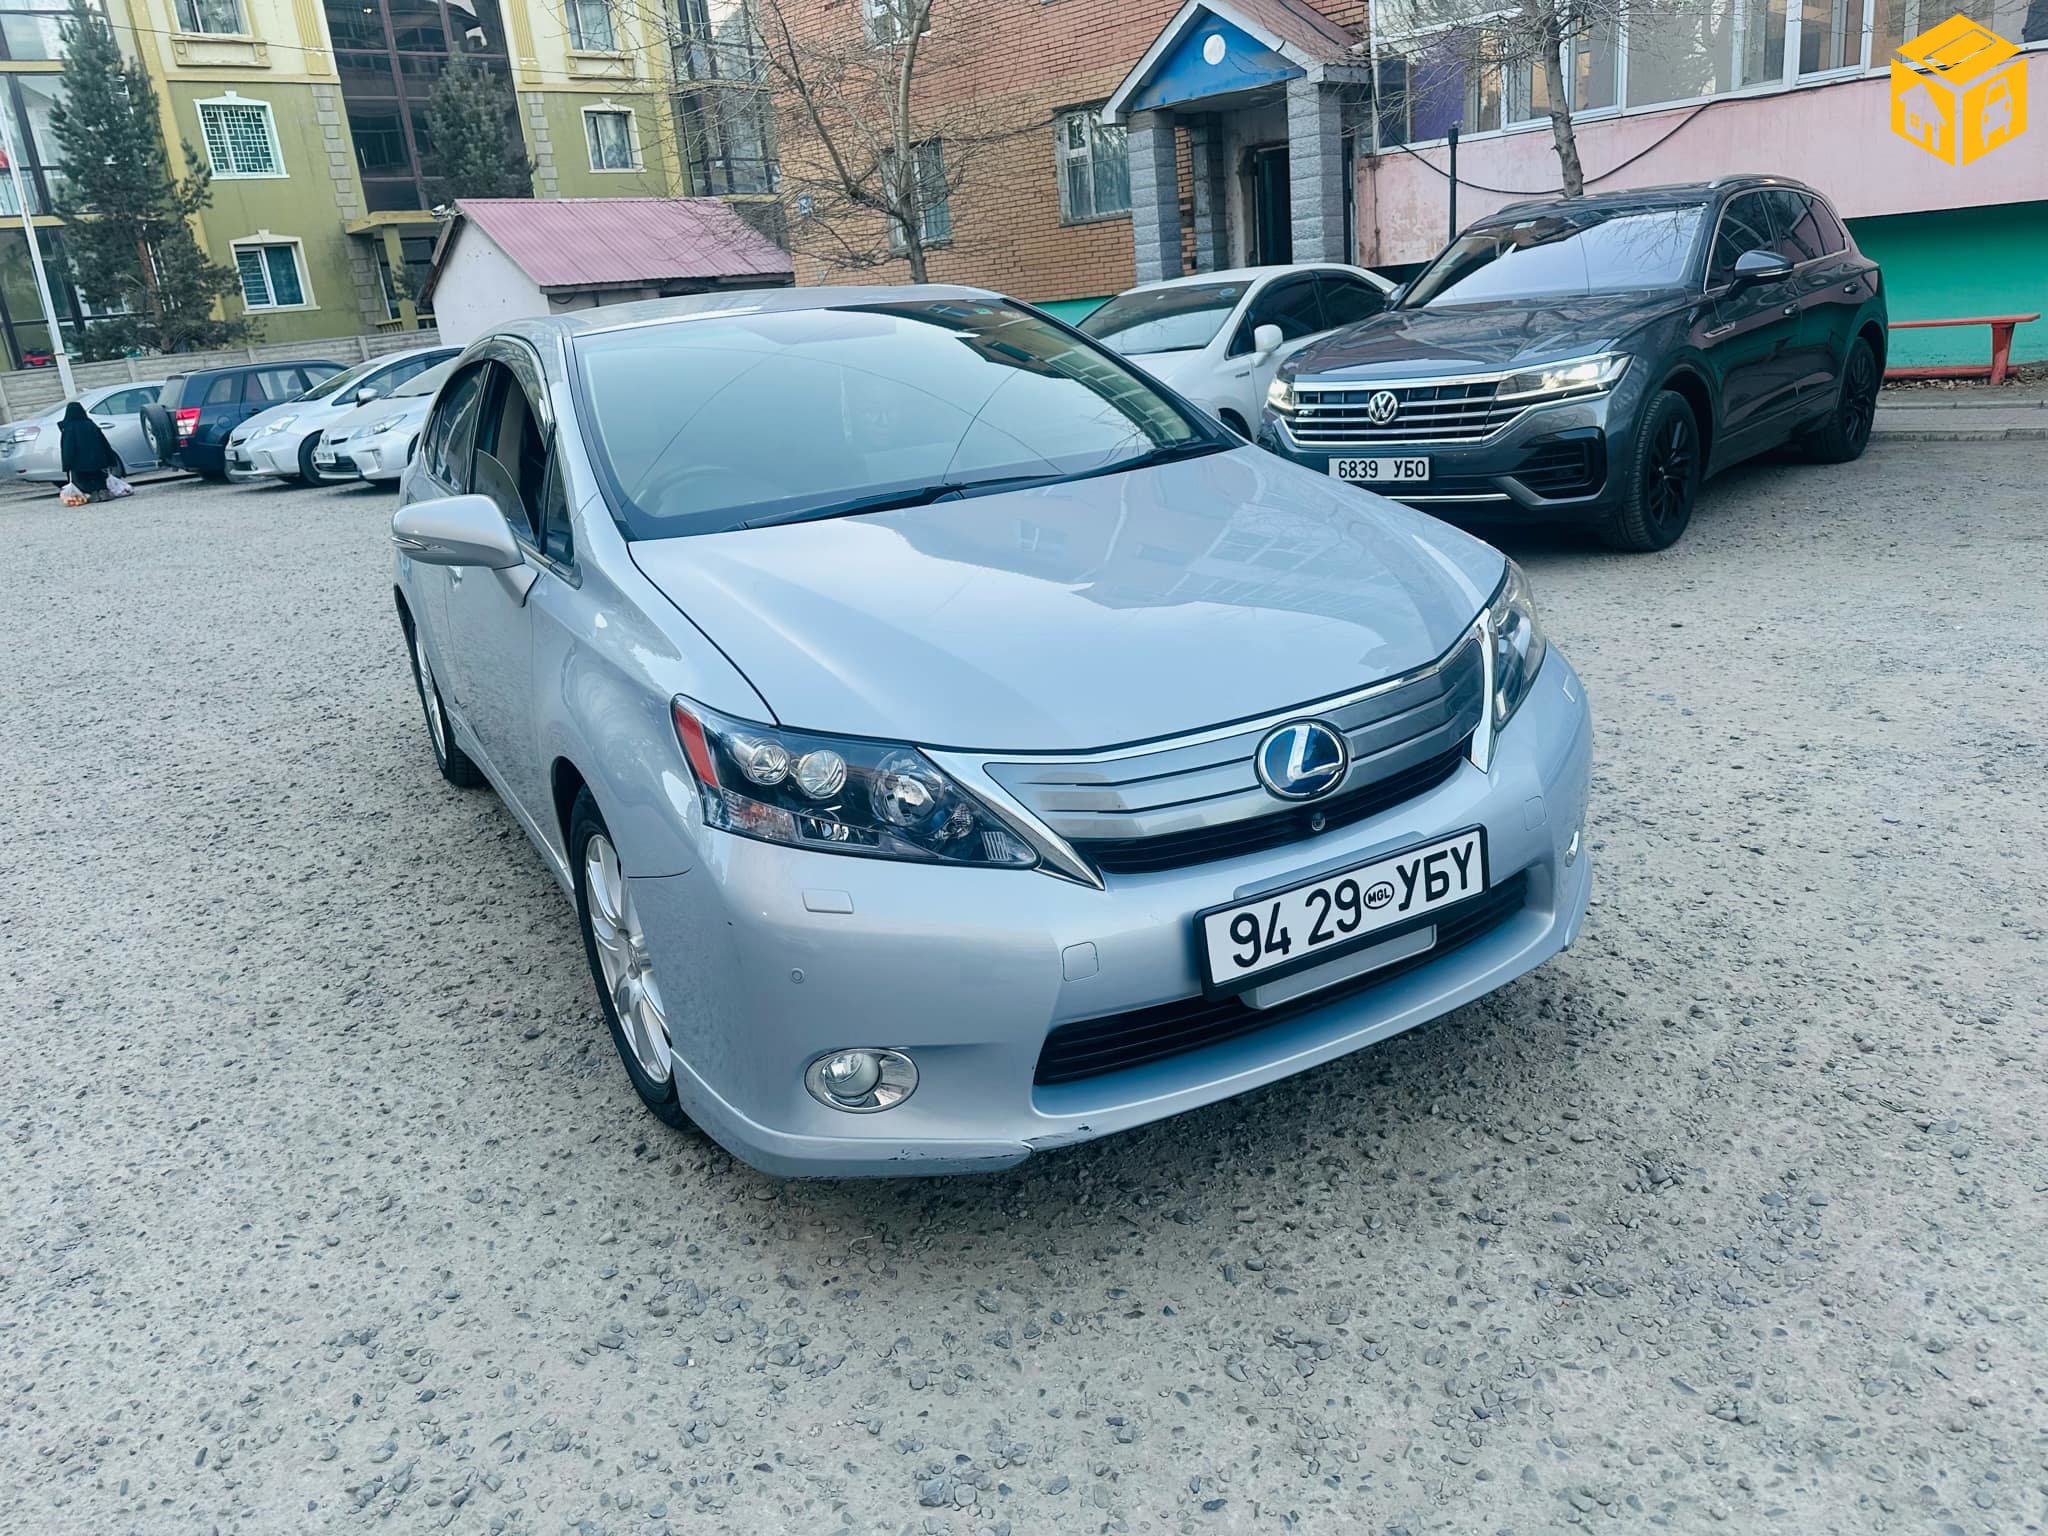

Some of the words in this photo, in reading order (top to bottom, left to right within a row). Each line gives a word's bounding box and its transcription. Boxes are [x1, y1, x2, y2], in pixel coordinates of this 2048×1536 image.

[1338, 460, 1379, 479] 6839
[1393, 460, 1426, 479] УБО
[1229, 901, 1292, 968] 94
[1304, 878, 1363, 946] 29
[1367, 887, 1391, 905] MGL
